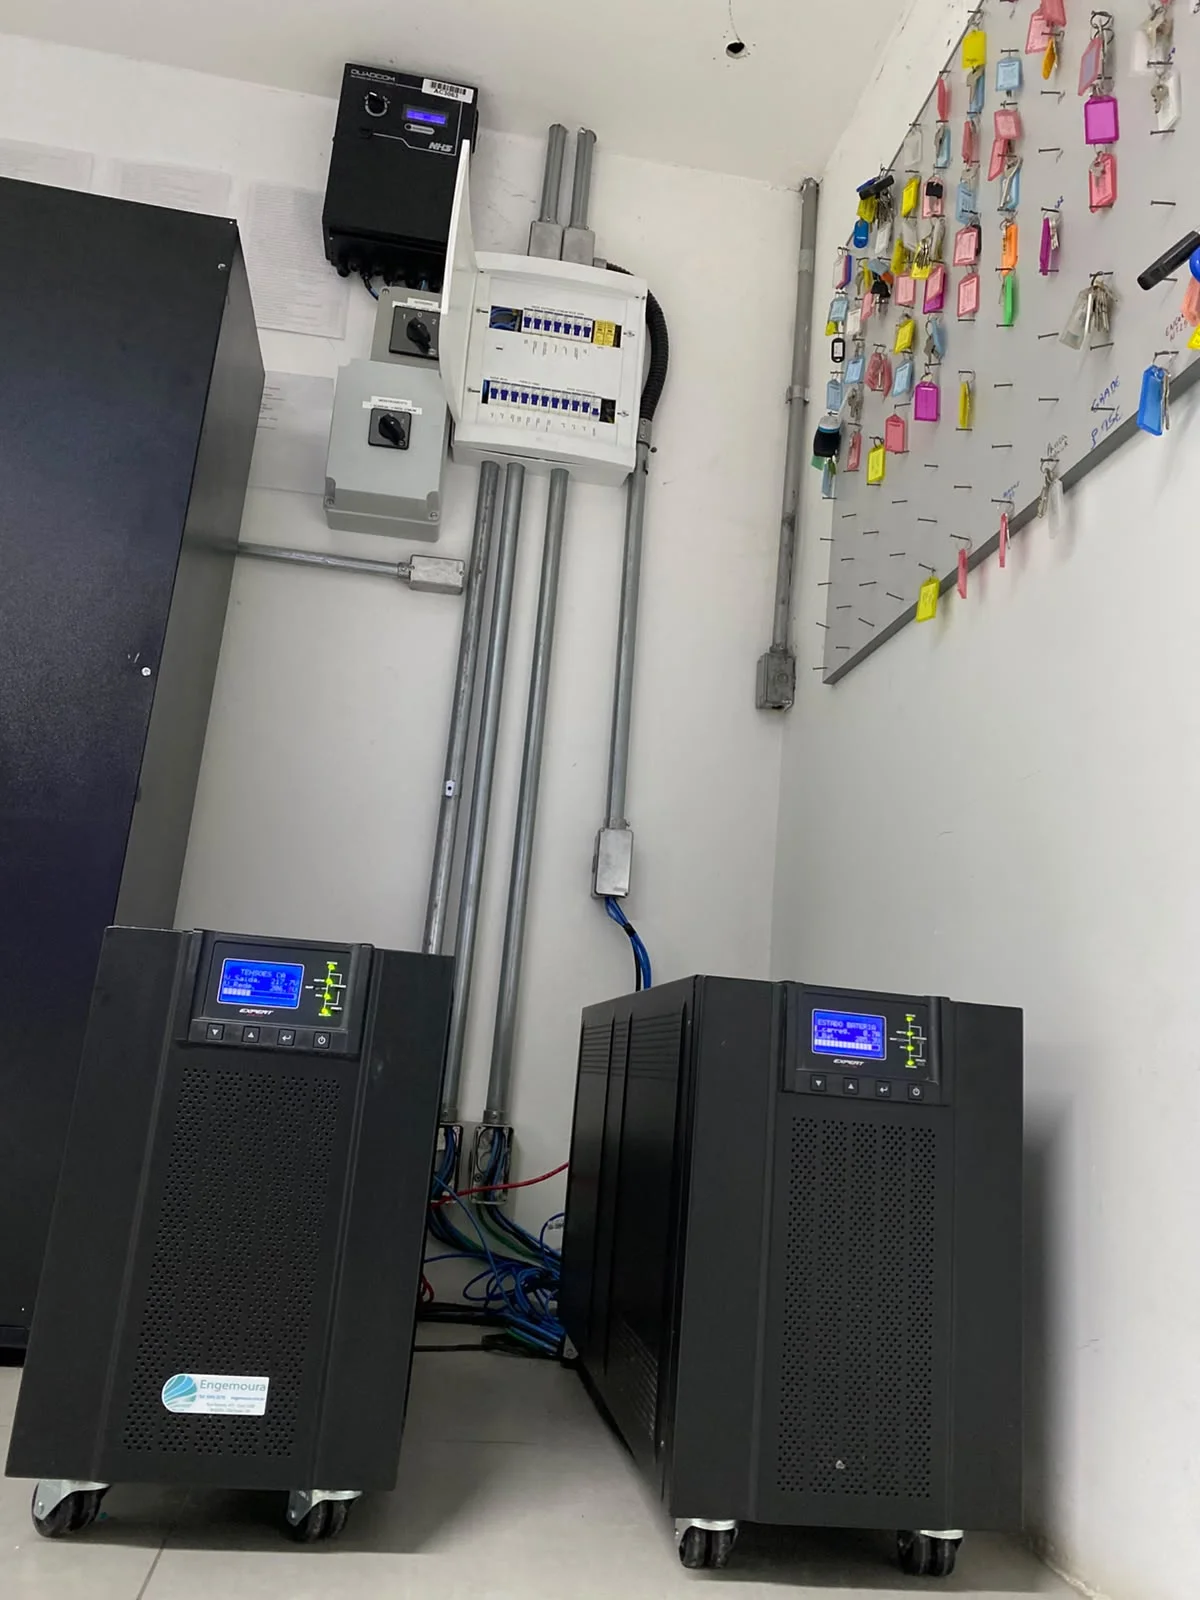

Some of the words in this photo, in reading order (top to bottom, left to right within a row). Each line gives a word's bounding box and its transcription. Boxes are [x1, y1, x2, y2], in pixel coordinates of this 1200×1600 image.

[428, 141, 453, 153] NHS
[833, 1058, 864, 1066] EXPERT
[200, 1379, 267, 1393] Engemoura
